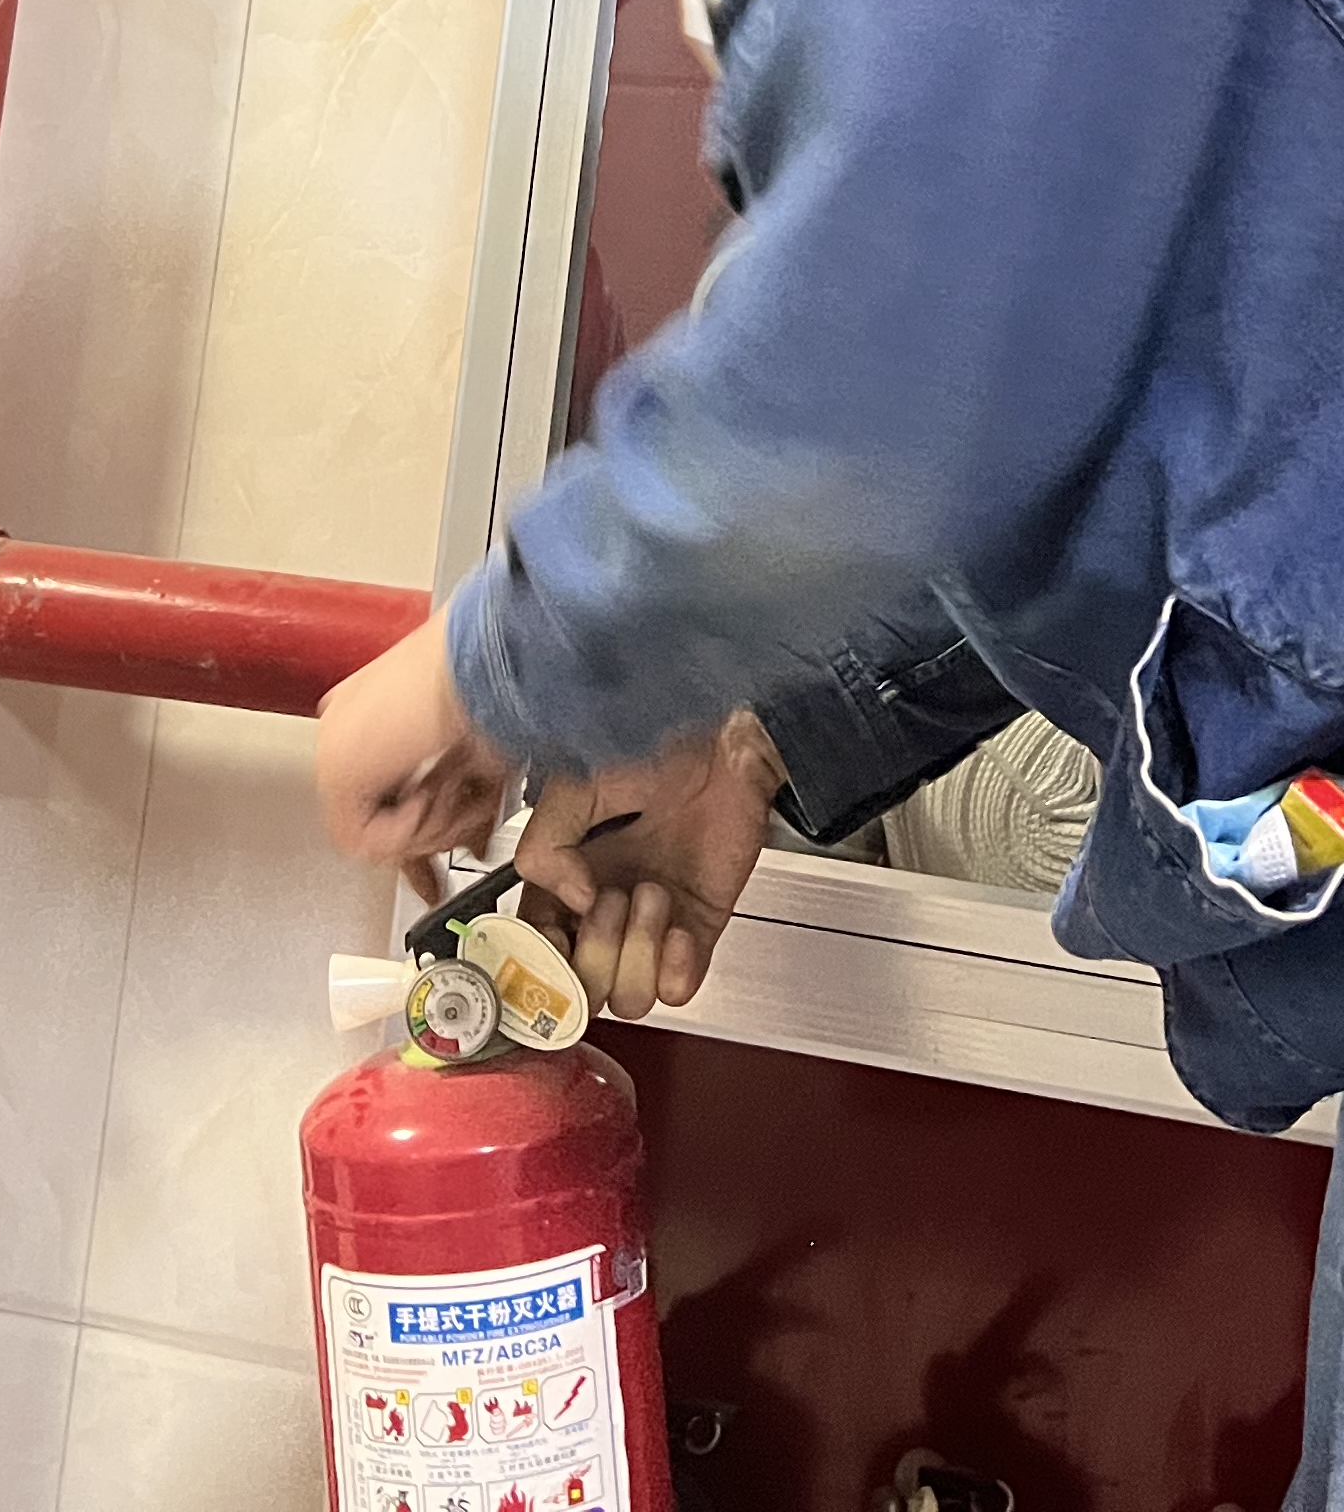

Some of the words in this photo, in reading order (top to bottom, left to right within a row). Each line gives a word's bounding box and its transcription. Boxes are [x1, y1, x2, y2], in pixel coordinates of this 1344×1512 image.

[395, 1284, 577, 1332] 手提式干粉灭火器
[442, 1333, 561, 1367] MFZ/ABC3A
